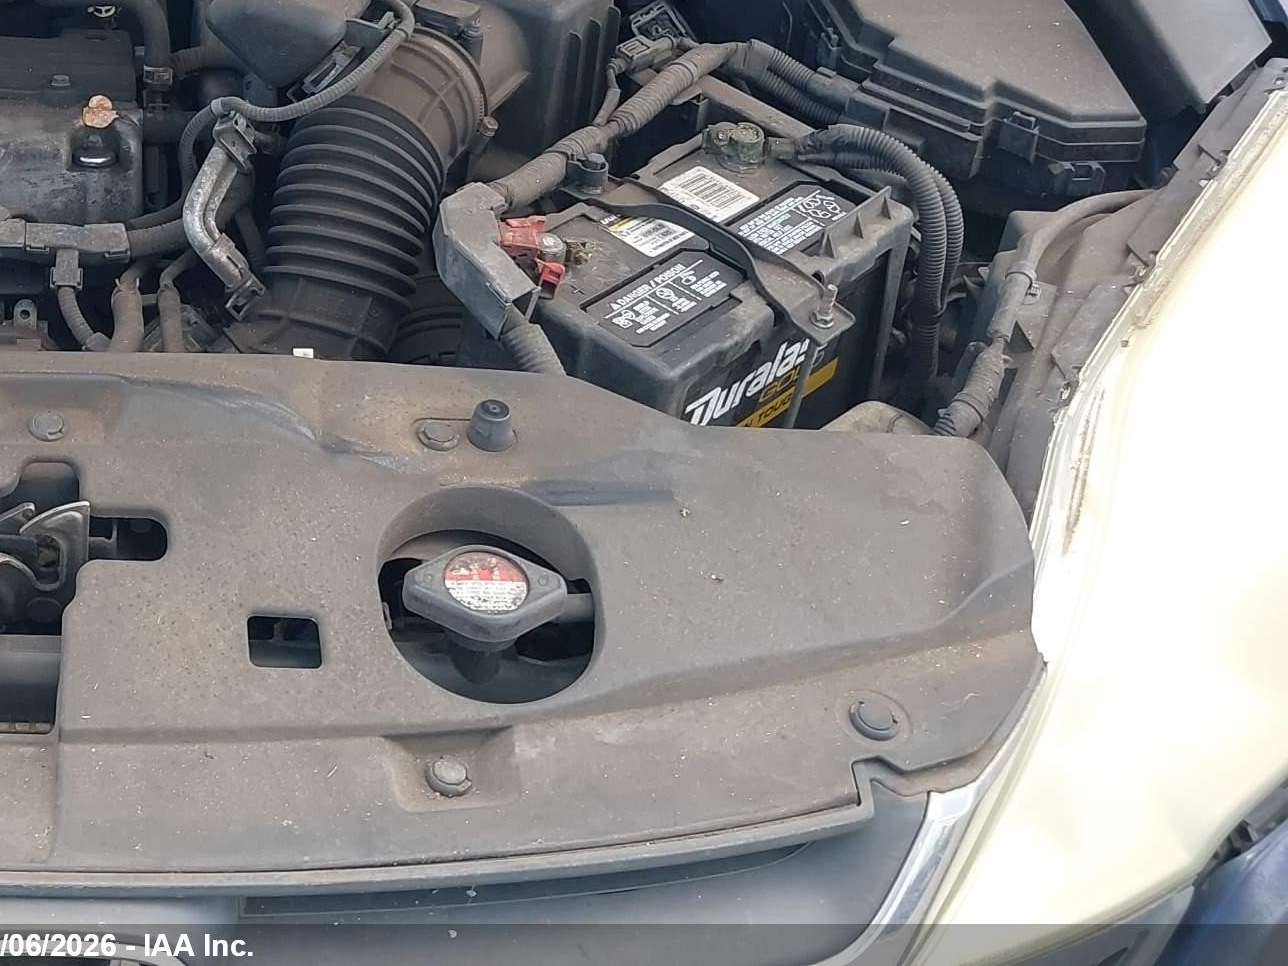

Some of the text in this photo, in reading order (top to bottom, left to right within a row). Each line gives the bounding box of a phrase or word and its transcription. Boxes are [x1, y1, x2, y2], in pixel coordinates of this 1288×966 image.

[616, 284, 653, 306] DANGER
[653, 263, 686, 284] POISON
[684, 338, 811, 427] Duralas
